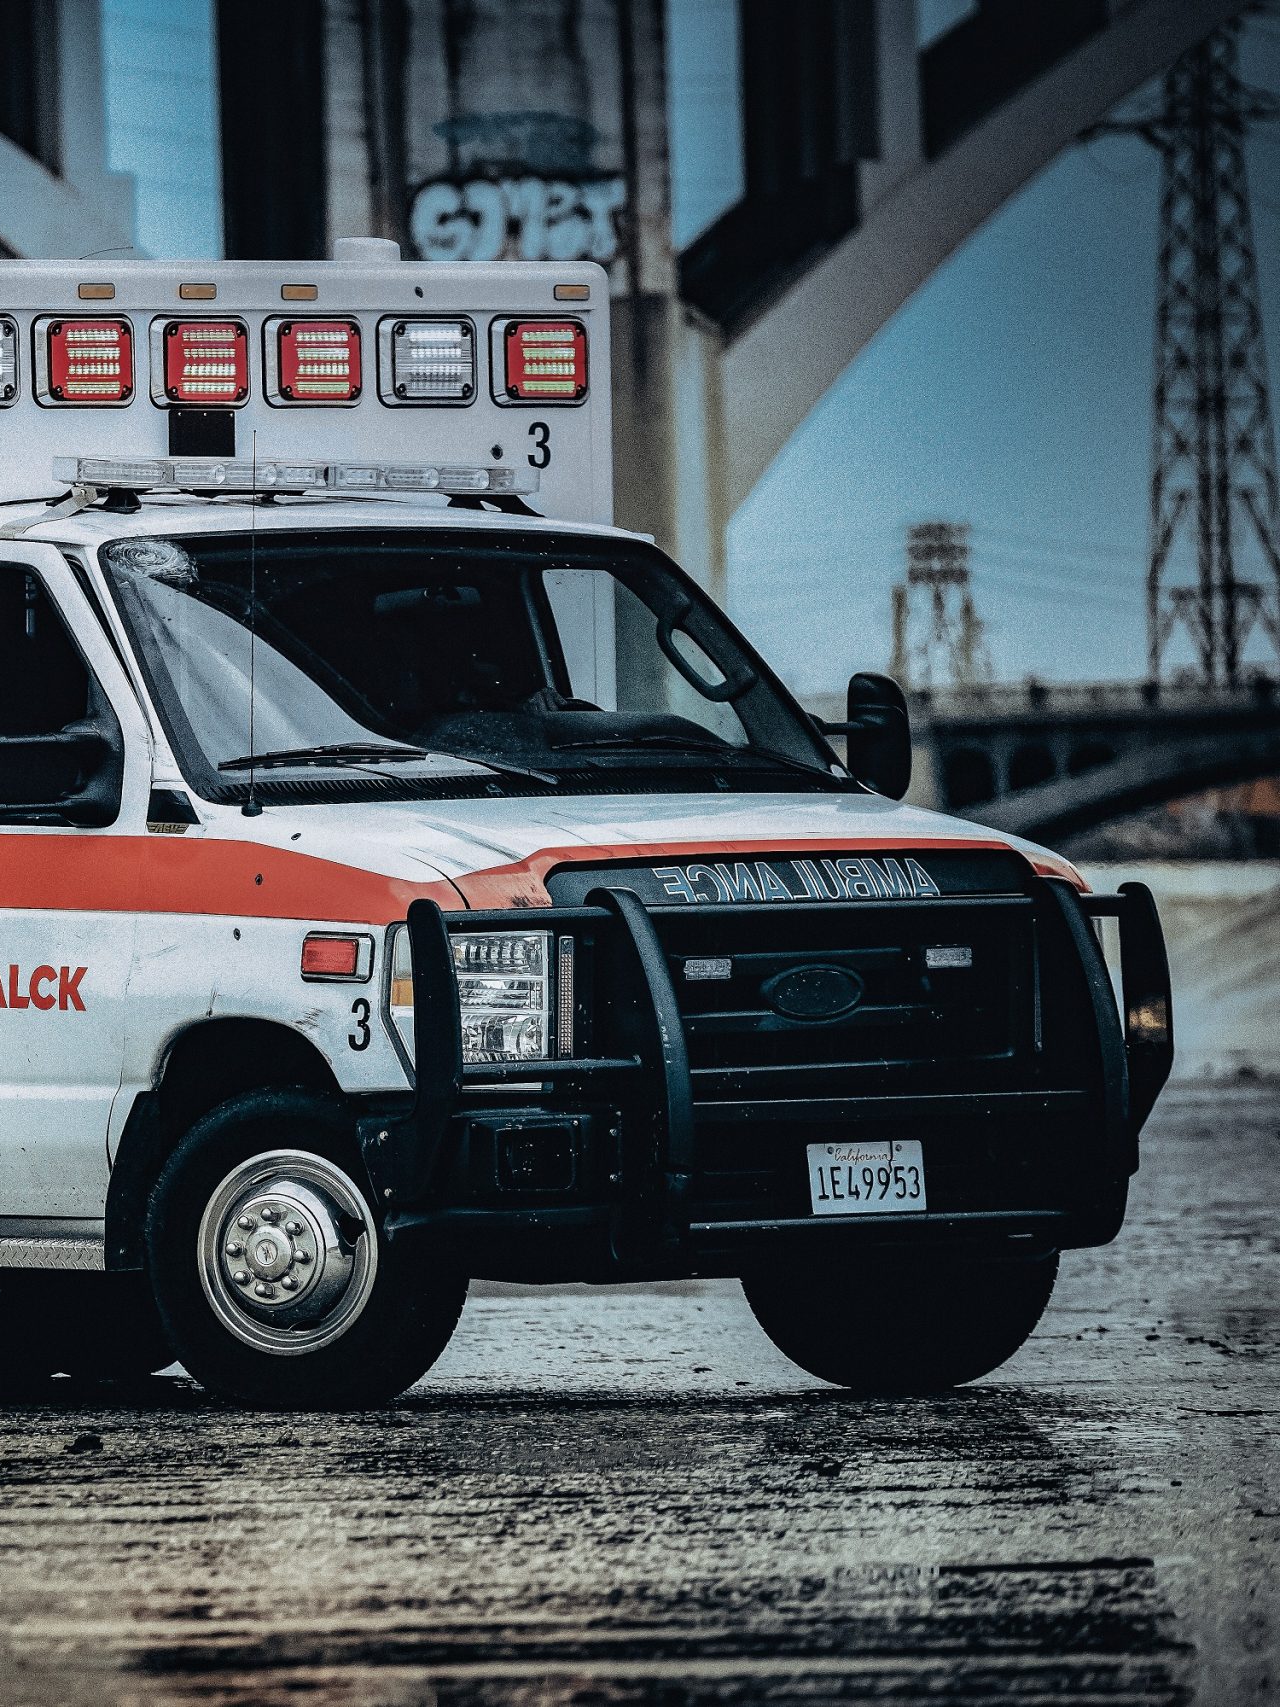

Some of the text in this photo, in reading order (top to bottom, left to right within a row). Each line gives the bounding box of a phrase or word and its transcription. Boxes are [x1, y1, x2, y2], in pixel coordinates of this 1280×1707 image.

[528, 422, 551, 469] 3
[348, 998, 370, 1051] 3
[835, 1147, 891, 1165] California
[818, 1166, 920, 1200] 1E49953
